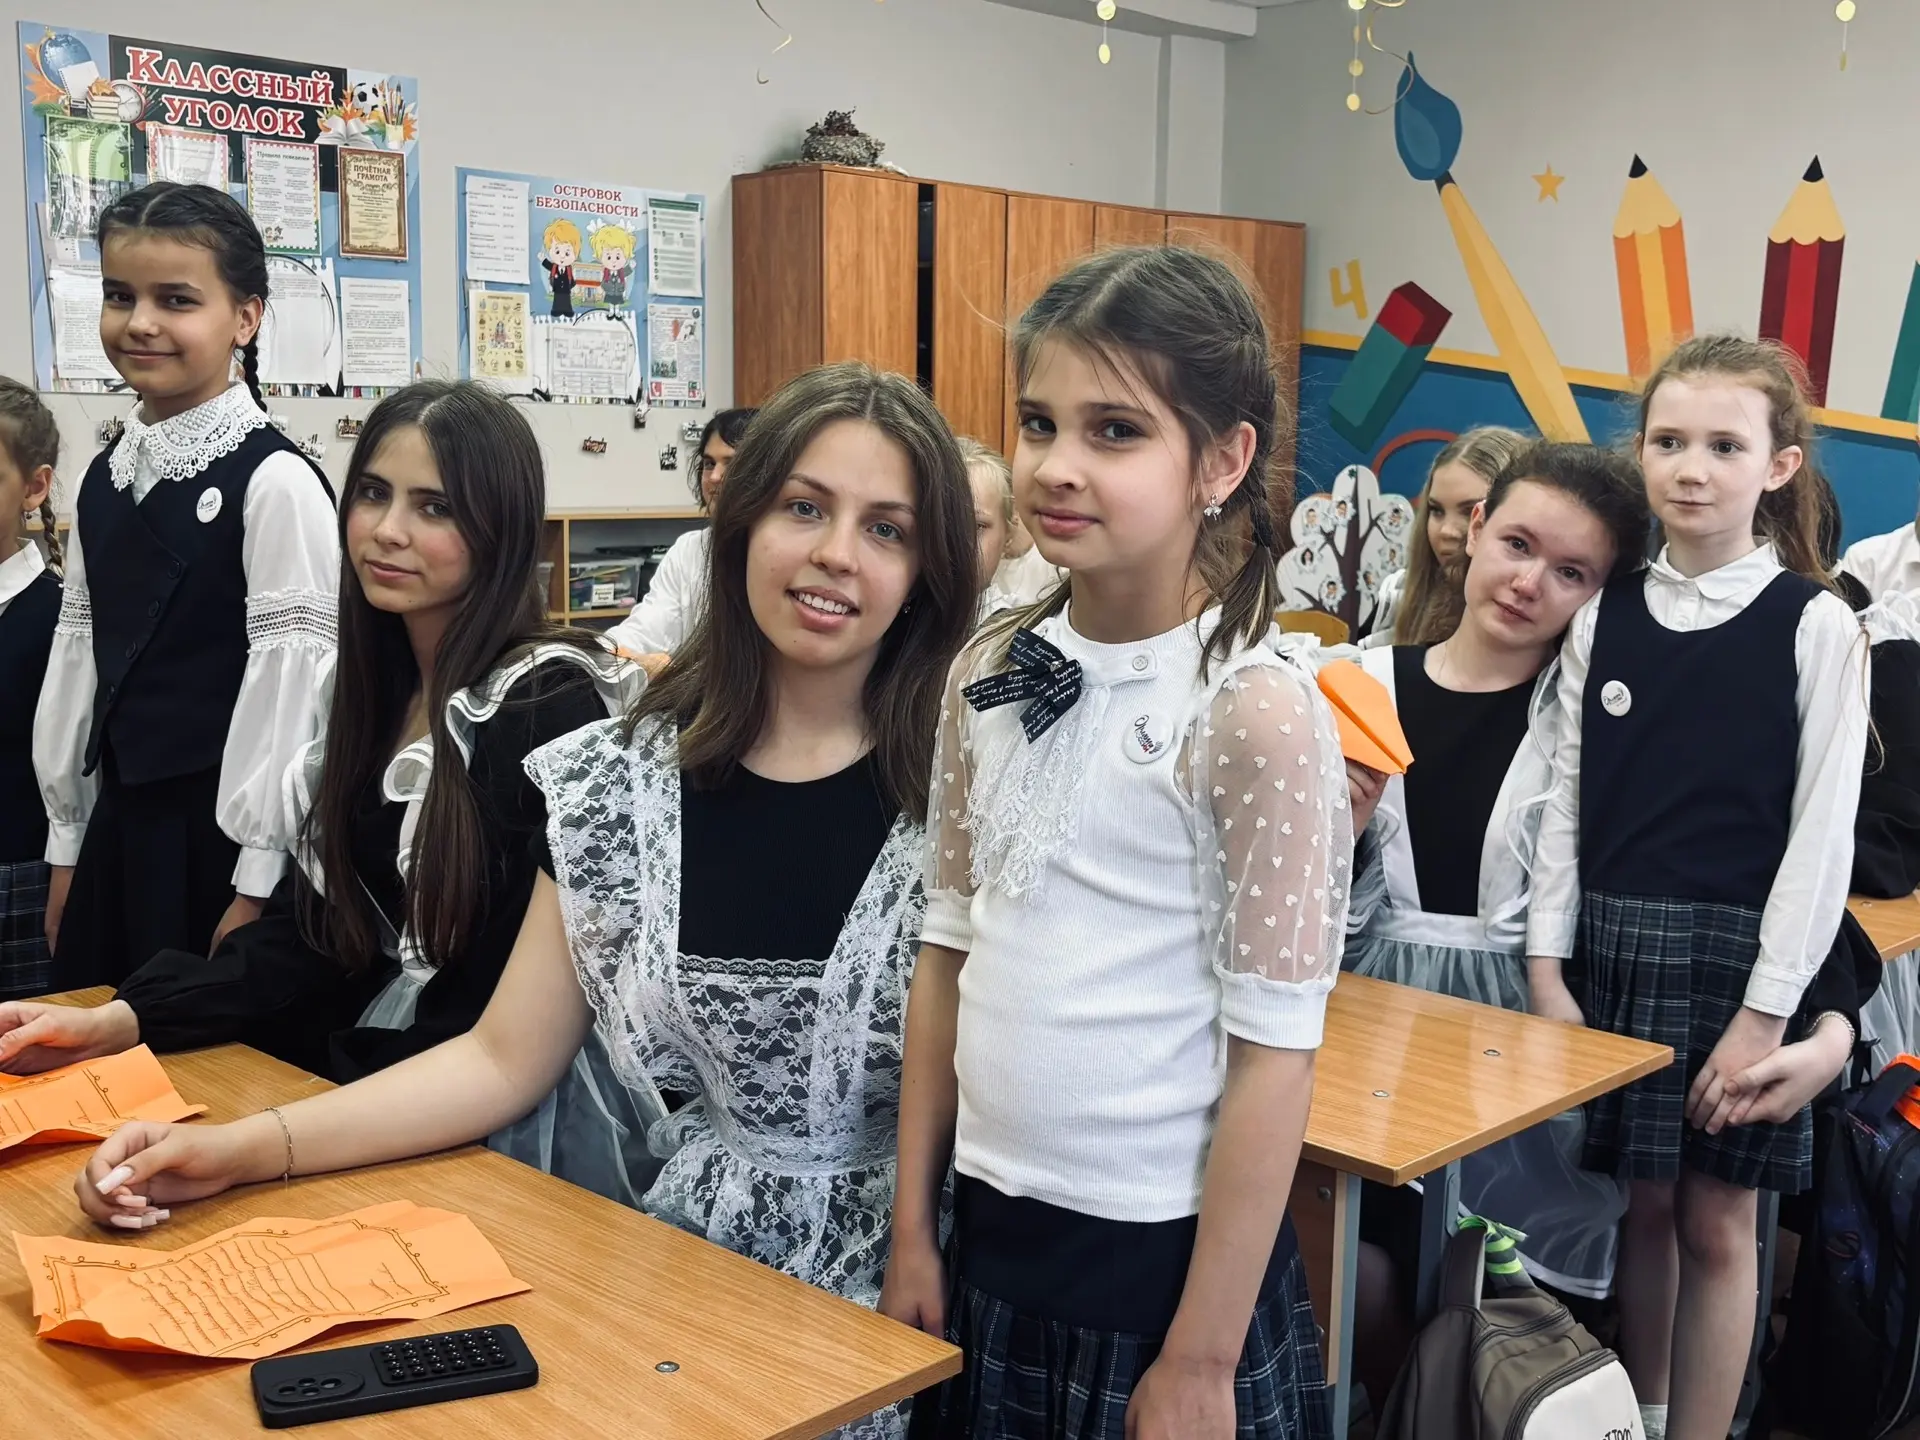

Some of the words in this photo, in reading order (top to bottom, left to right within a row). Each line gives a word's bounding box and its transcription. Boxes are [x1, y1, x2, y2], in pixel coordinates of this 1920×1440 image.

[126, 48, 333, 105] КЛАССНЫЙ
[163, 95, 305, 138] УГОЛОК
[357, 172, 388, 182] ГРАМОТА
[553, 184, 622, 201] ОСТРОВОК
[536, 196, 639, 217] БЕЗОПАСНОСТИ
[1329, 258, 1368, 320] 4
